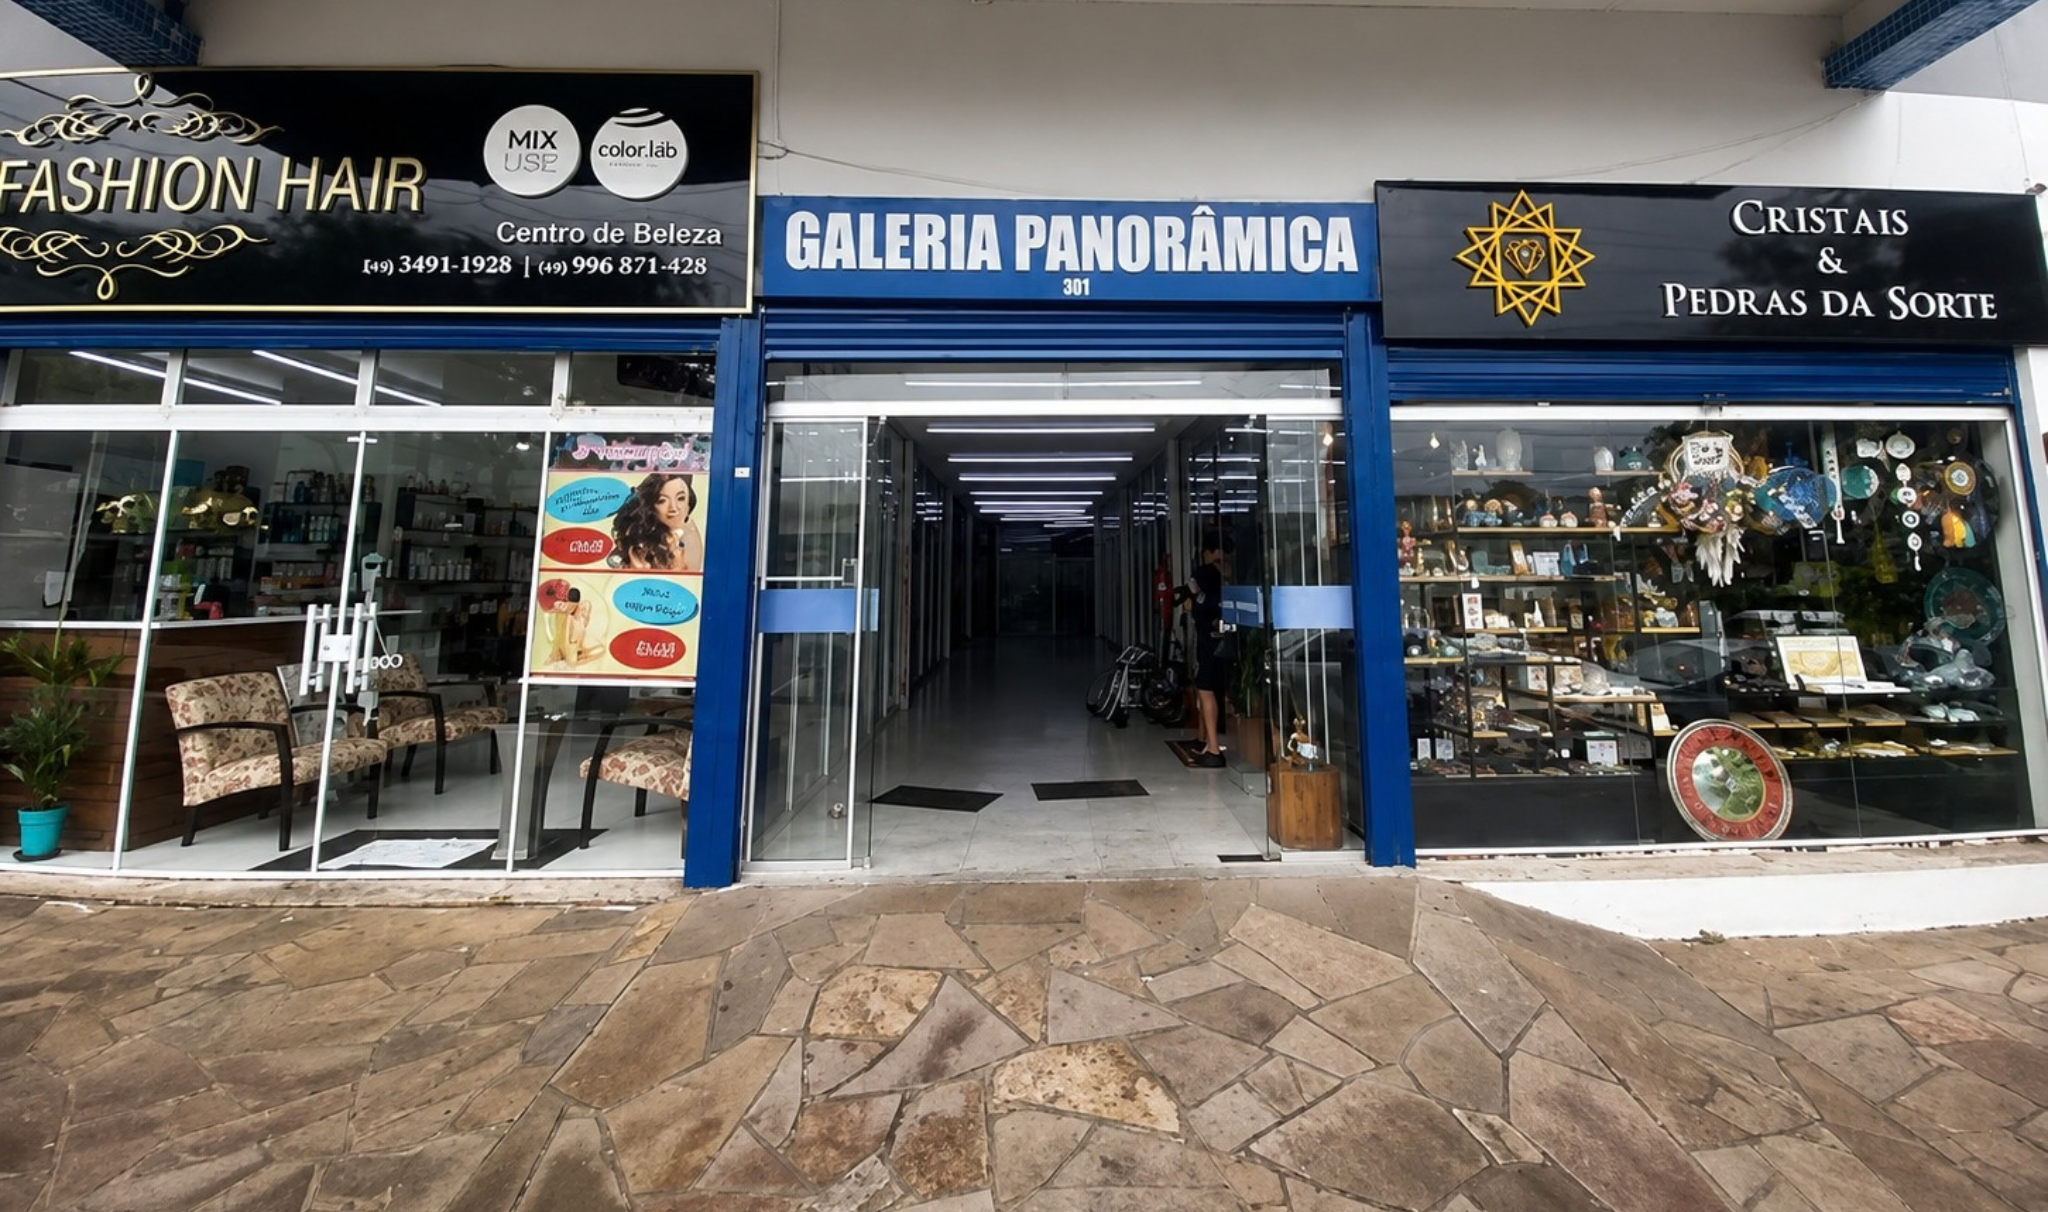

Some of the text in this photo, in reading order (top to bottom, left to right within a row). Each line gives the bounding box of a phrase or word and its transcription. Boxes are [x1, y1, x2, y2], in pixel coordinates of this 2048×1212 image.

[508, 130, 558, 150] MIX
[0, 156, 427, 213] FASHION HAIR
[497, 221, 723, 246] Centro de Beleza
[785, 205, 1358, 273] GALERIA PANORÂMICA
[399, 254, 512, 274] 3491-1928
[571, 255, 614, 275] 996
[618, 256, 707, 275] 871-428
[1817, 246, 1848, 274] &
[1063, 277, 1090, 296] 301
[1663, 282, 1998, 320] PEDRAS DA SORTE
